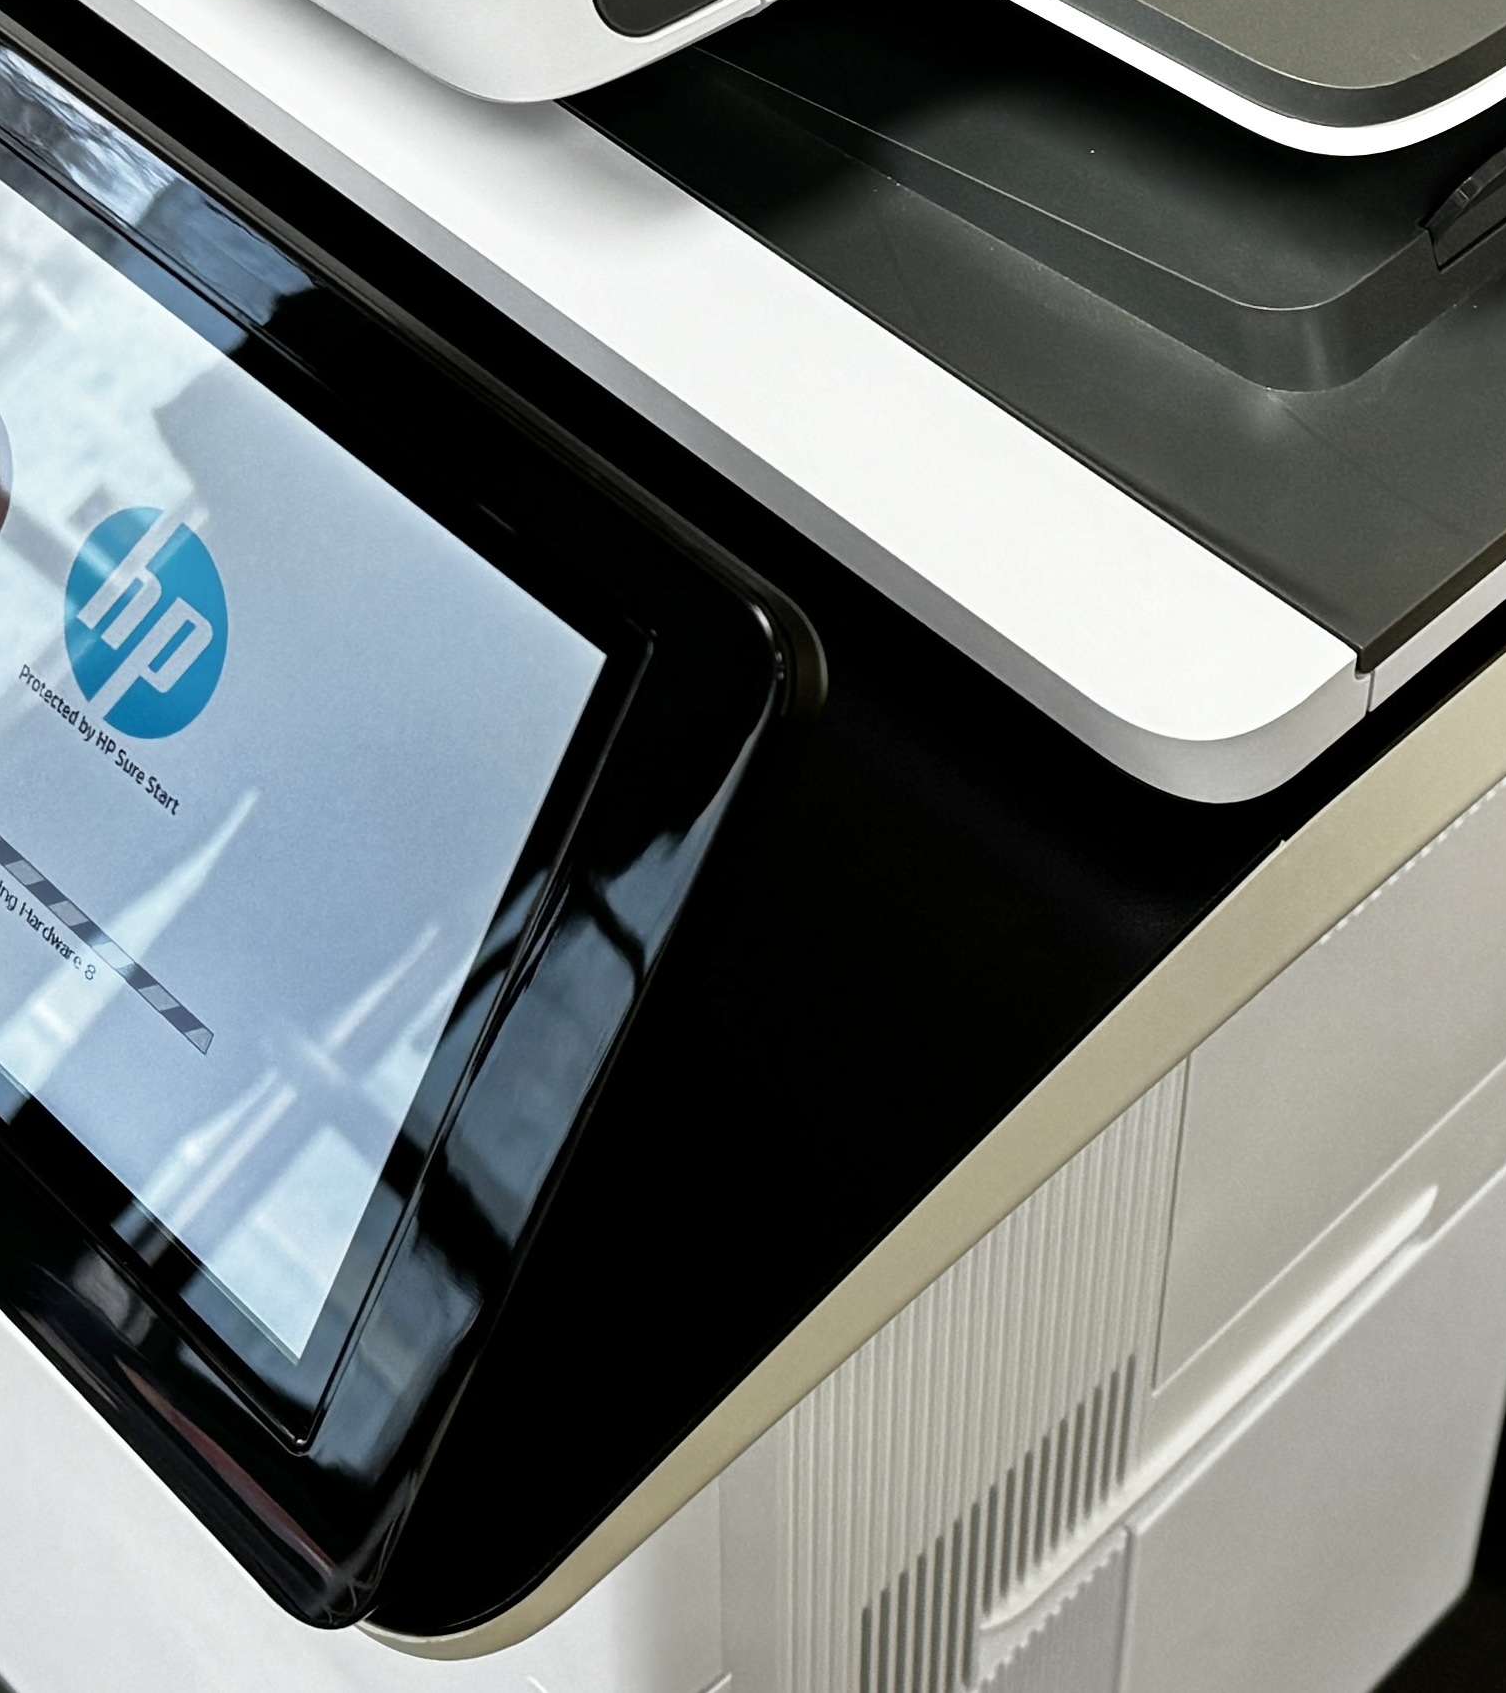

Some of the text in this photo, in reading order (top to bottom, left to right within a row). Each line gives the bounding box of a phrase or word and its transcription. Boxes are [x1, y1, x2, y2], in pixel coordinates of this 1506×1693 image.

[75, 506, 214, 720] hp
[18, 663, 181, 816] Protected by HP Sure Start
[18, 901, 83, 970] Hardware
